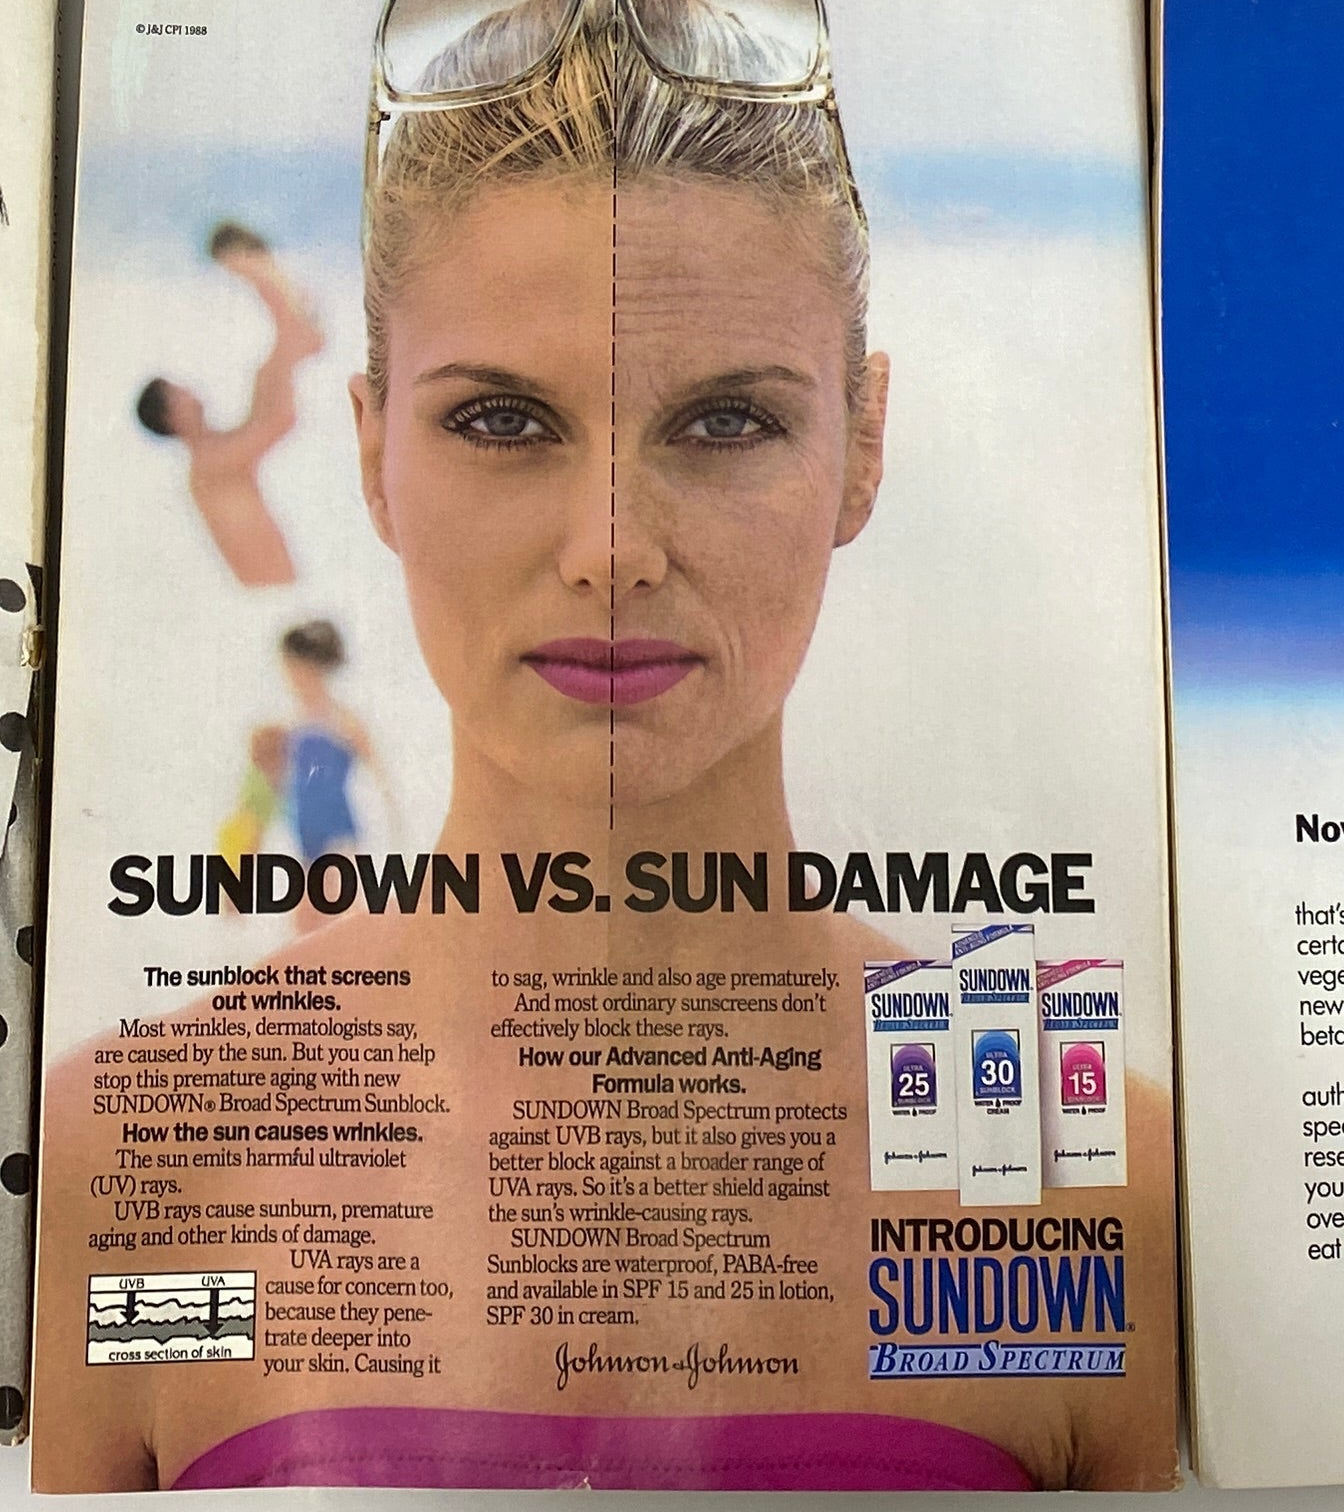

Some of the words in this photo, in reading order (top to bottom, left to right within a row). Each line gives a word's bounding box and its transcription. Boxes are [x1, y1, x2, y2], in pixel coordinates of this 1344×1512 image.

[146, 24, 164, 36] J&J
[165, 24, 183, 36] CPI
[185, 25, 208, 37] 1988
[108, 851, 480, 917] SUNDOWN
[501, 852, 610, 913] VS.
[625, 852, 768, 912] SUN
[788, 852, 1095, 914] DAMAGE
[143, 967, 182, 987] The
[187, 965, 279, 986] sunblock
[284, 965, 327, 985] that
[331, 970, 411, 986] screens
[958, 968, 1032, 992] SUNDOWN
[212, 991, 247, 1011] out
[251, 990, 341, 1011] wrinkles.
[871, 992, 951, 1019] SUNDOWN
[1041, 992, 1120, 1018] SUNDOWN
[898, 1072, 931, 1097] 25
[980, 1059, 1015, 1086] 30
[1068, 1071, 1097, 1096] 15
[871, 1217, 1123, 1252] INTRODUCING
[118, 1276, 146, 1290] UVB
[201, 1274, 227, 1288] UVA
[868, 1254, 1126, 1337] SUNDOWN
[872, 1342, 970, 1375] BROAD
[978, 1338, 1125, 1374] SPECTRUM
